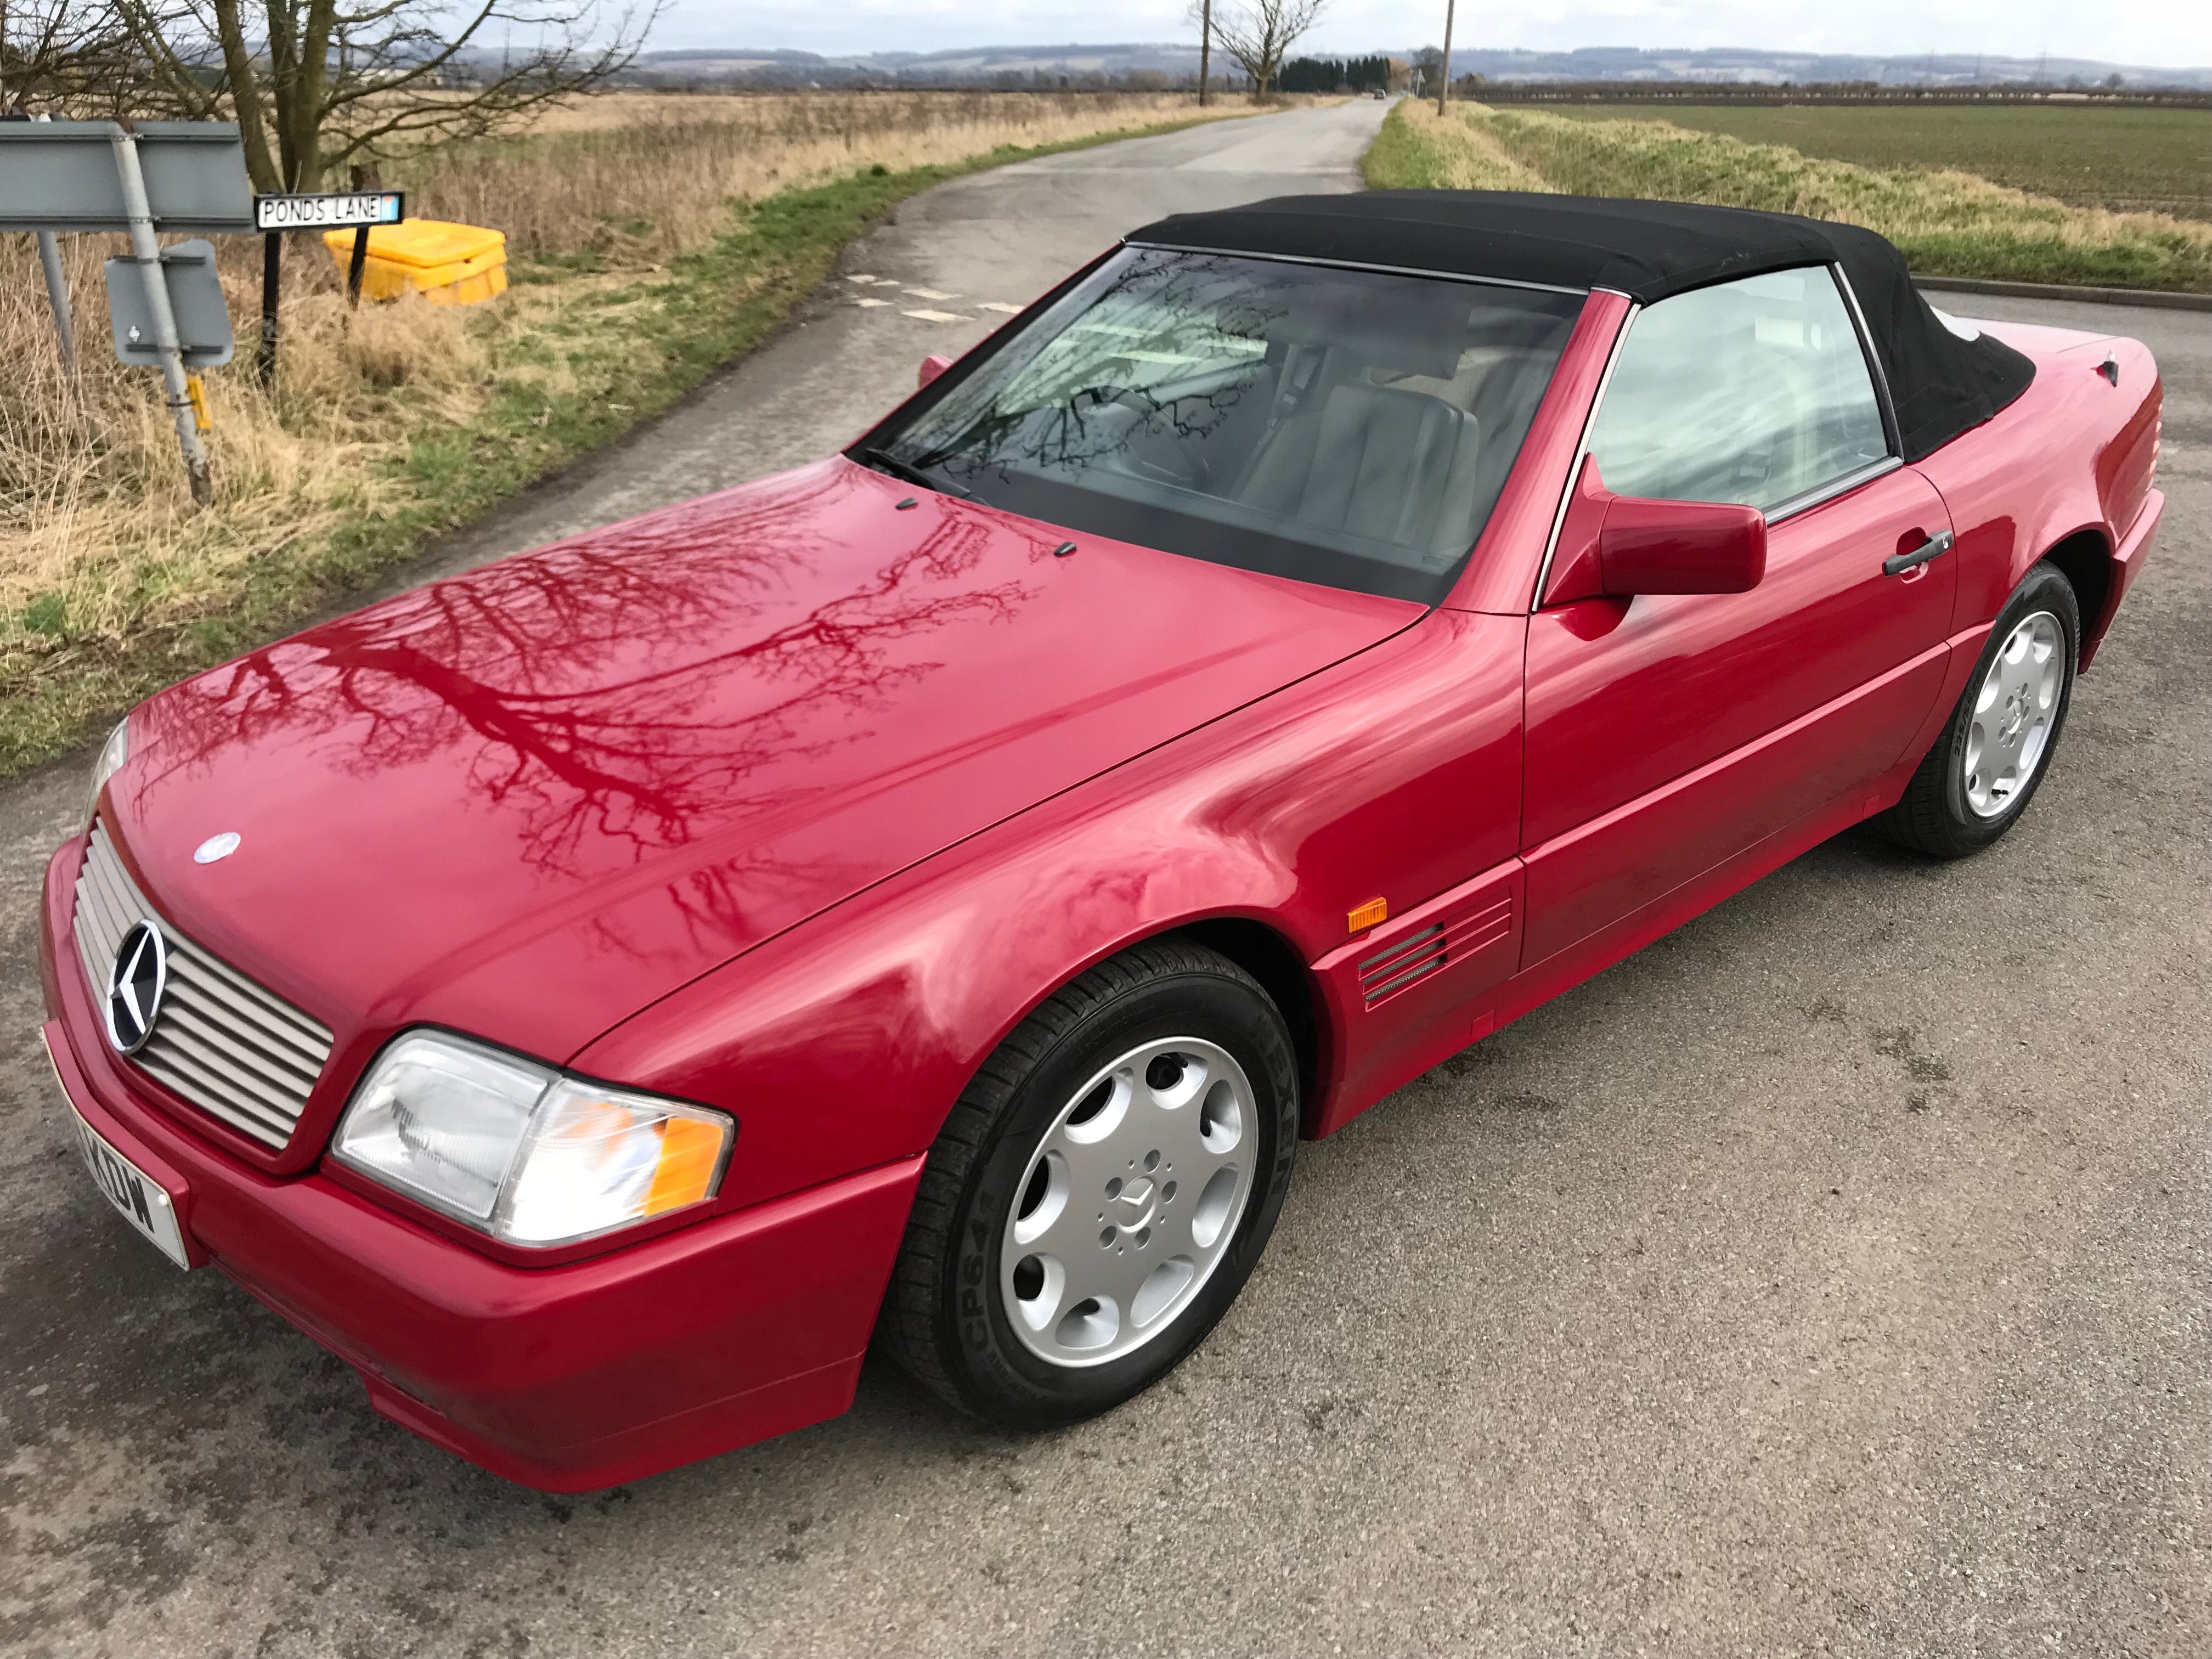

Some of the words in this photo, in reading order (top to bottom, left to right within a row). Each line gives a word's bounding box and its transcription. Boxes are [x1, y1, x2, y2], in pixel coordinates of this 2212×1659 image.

[264, 199, 325, 223] PONDS
[336, 197, 377, 219] LANE
[1252, 1012, 1296, 1195] NEXEN
